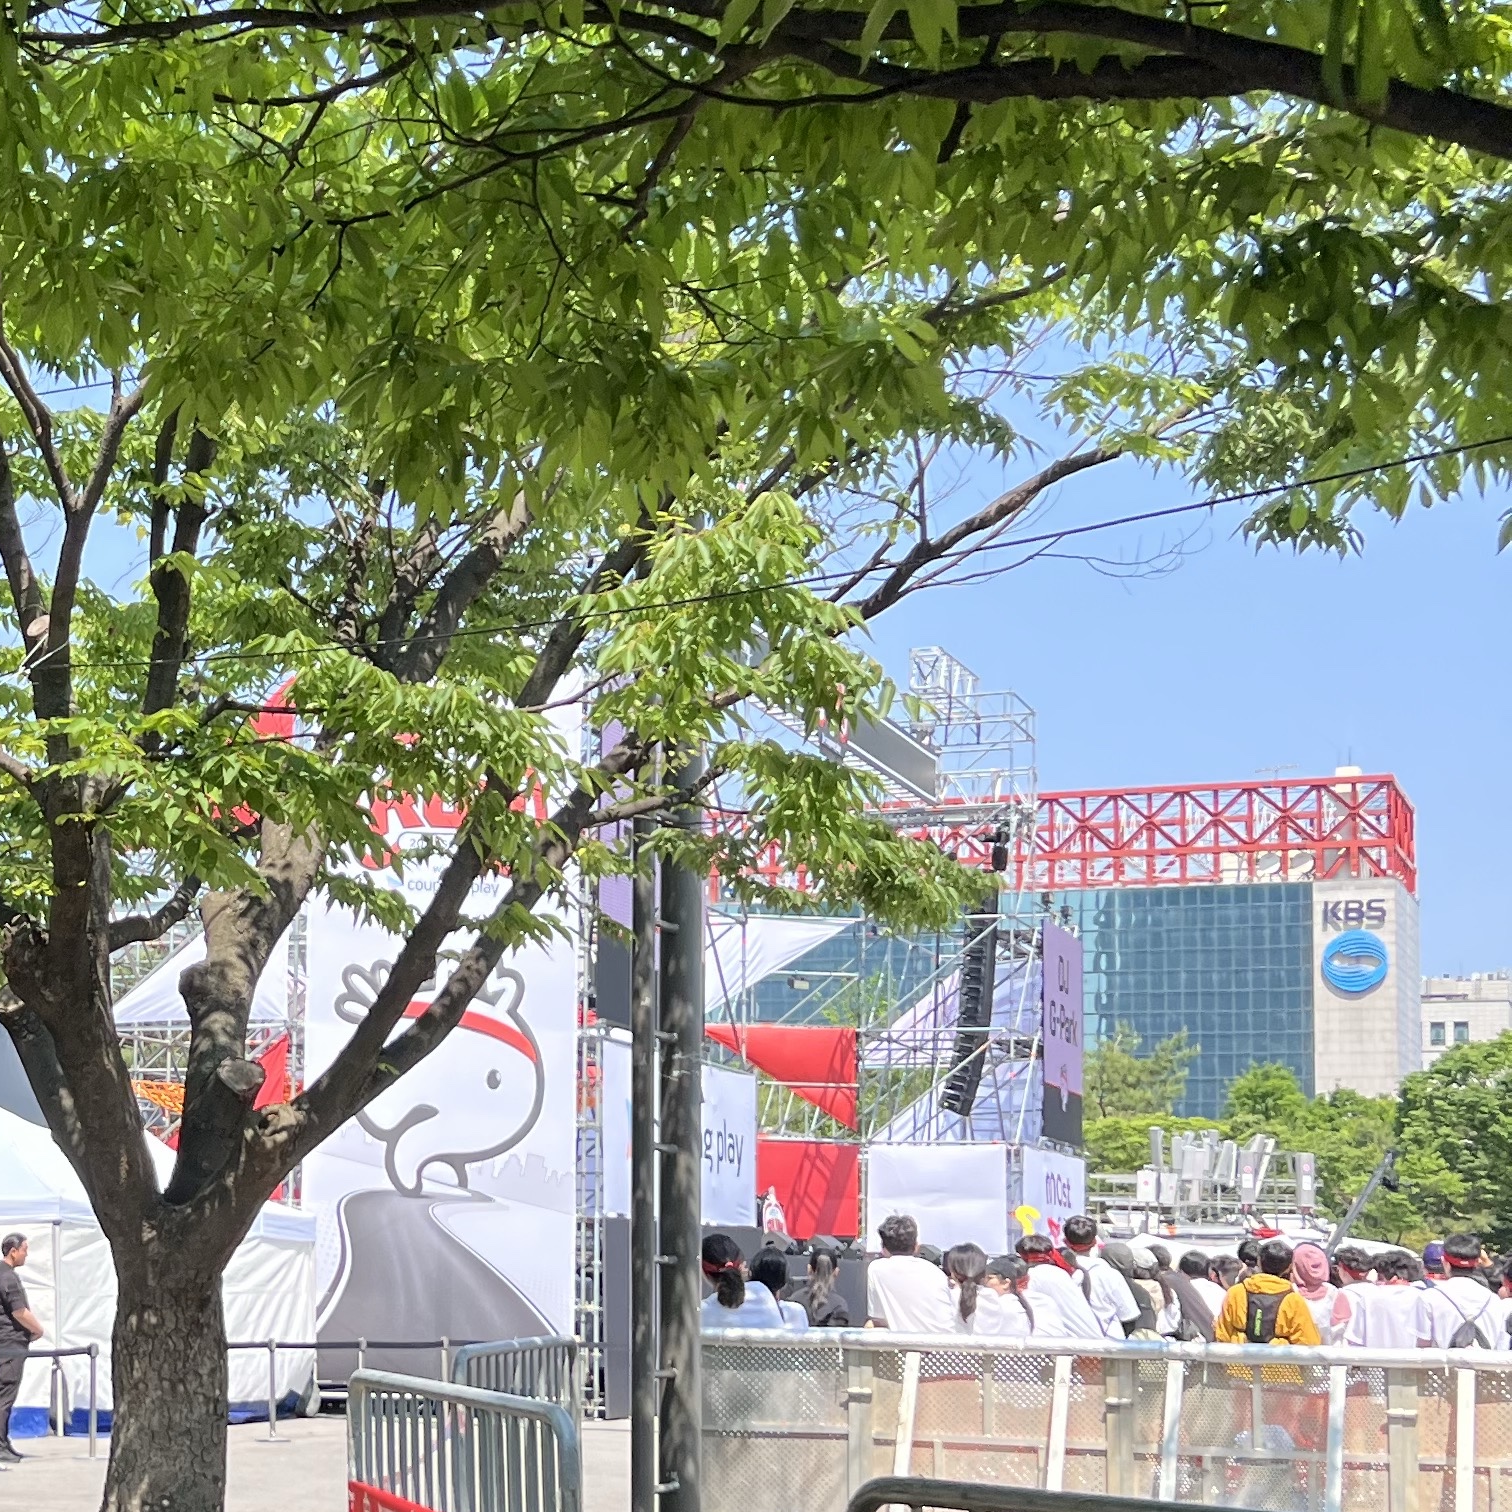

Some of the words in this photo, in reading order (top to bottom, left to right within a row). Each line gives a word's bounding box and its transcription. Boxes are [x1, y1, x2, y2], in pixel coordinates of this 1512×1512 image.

[1323, 898, 1387, 923] KBS
[1058, 955, 1070, 995] DJ
[1049, 999, 1078, 1048] G-Park
[717, 1119, 744, 1178] play
